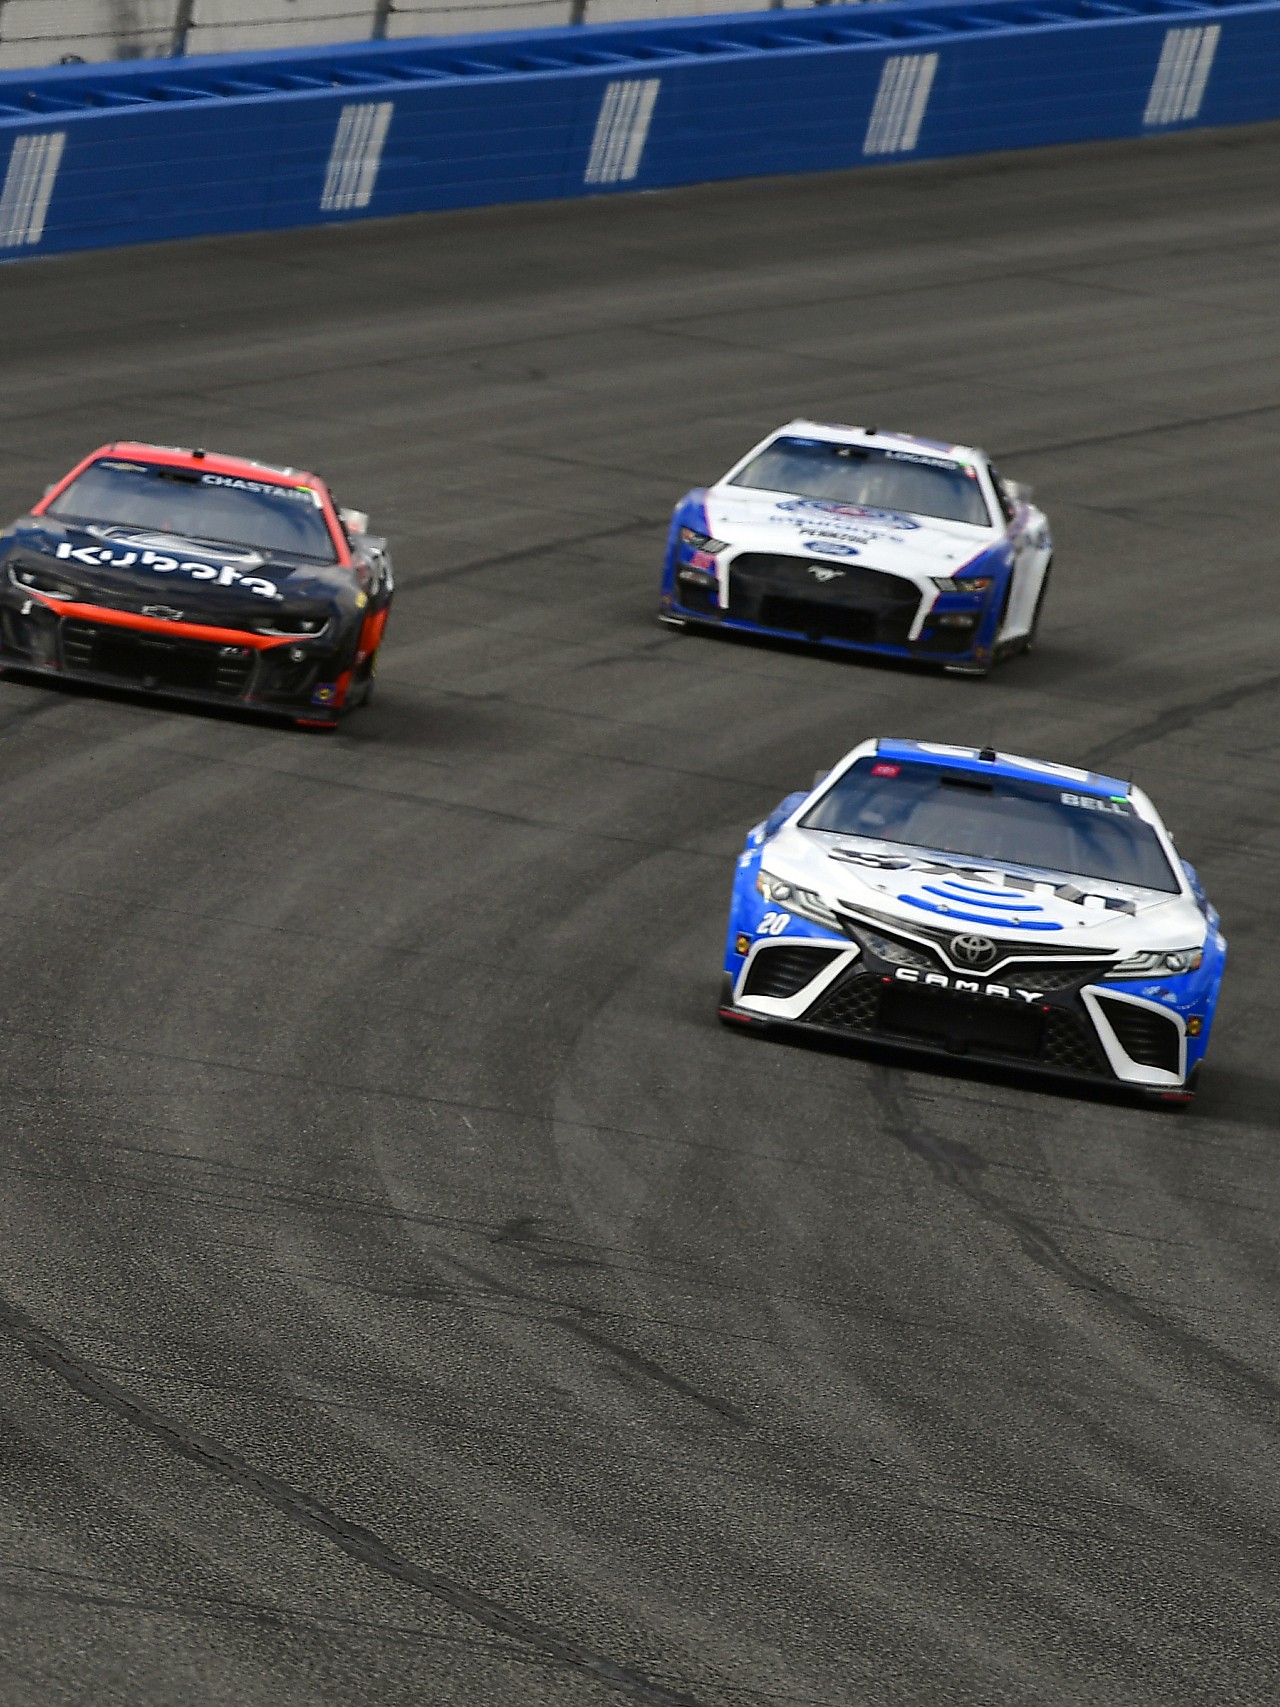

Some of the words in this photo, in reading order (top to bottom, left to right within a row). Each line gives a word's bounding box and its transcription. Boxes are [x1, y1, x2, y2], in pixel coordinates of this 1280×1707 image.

[1060, 792, 1129, 817] BELL
[756, 911, 791, 935] 20
[895, 967, 1044, 1003] CAMRY
